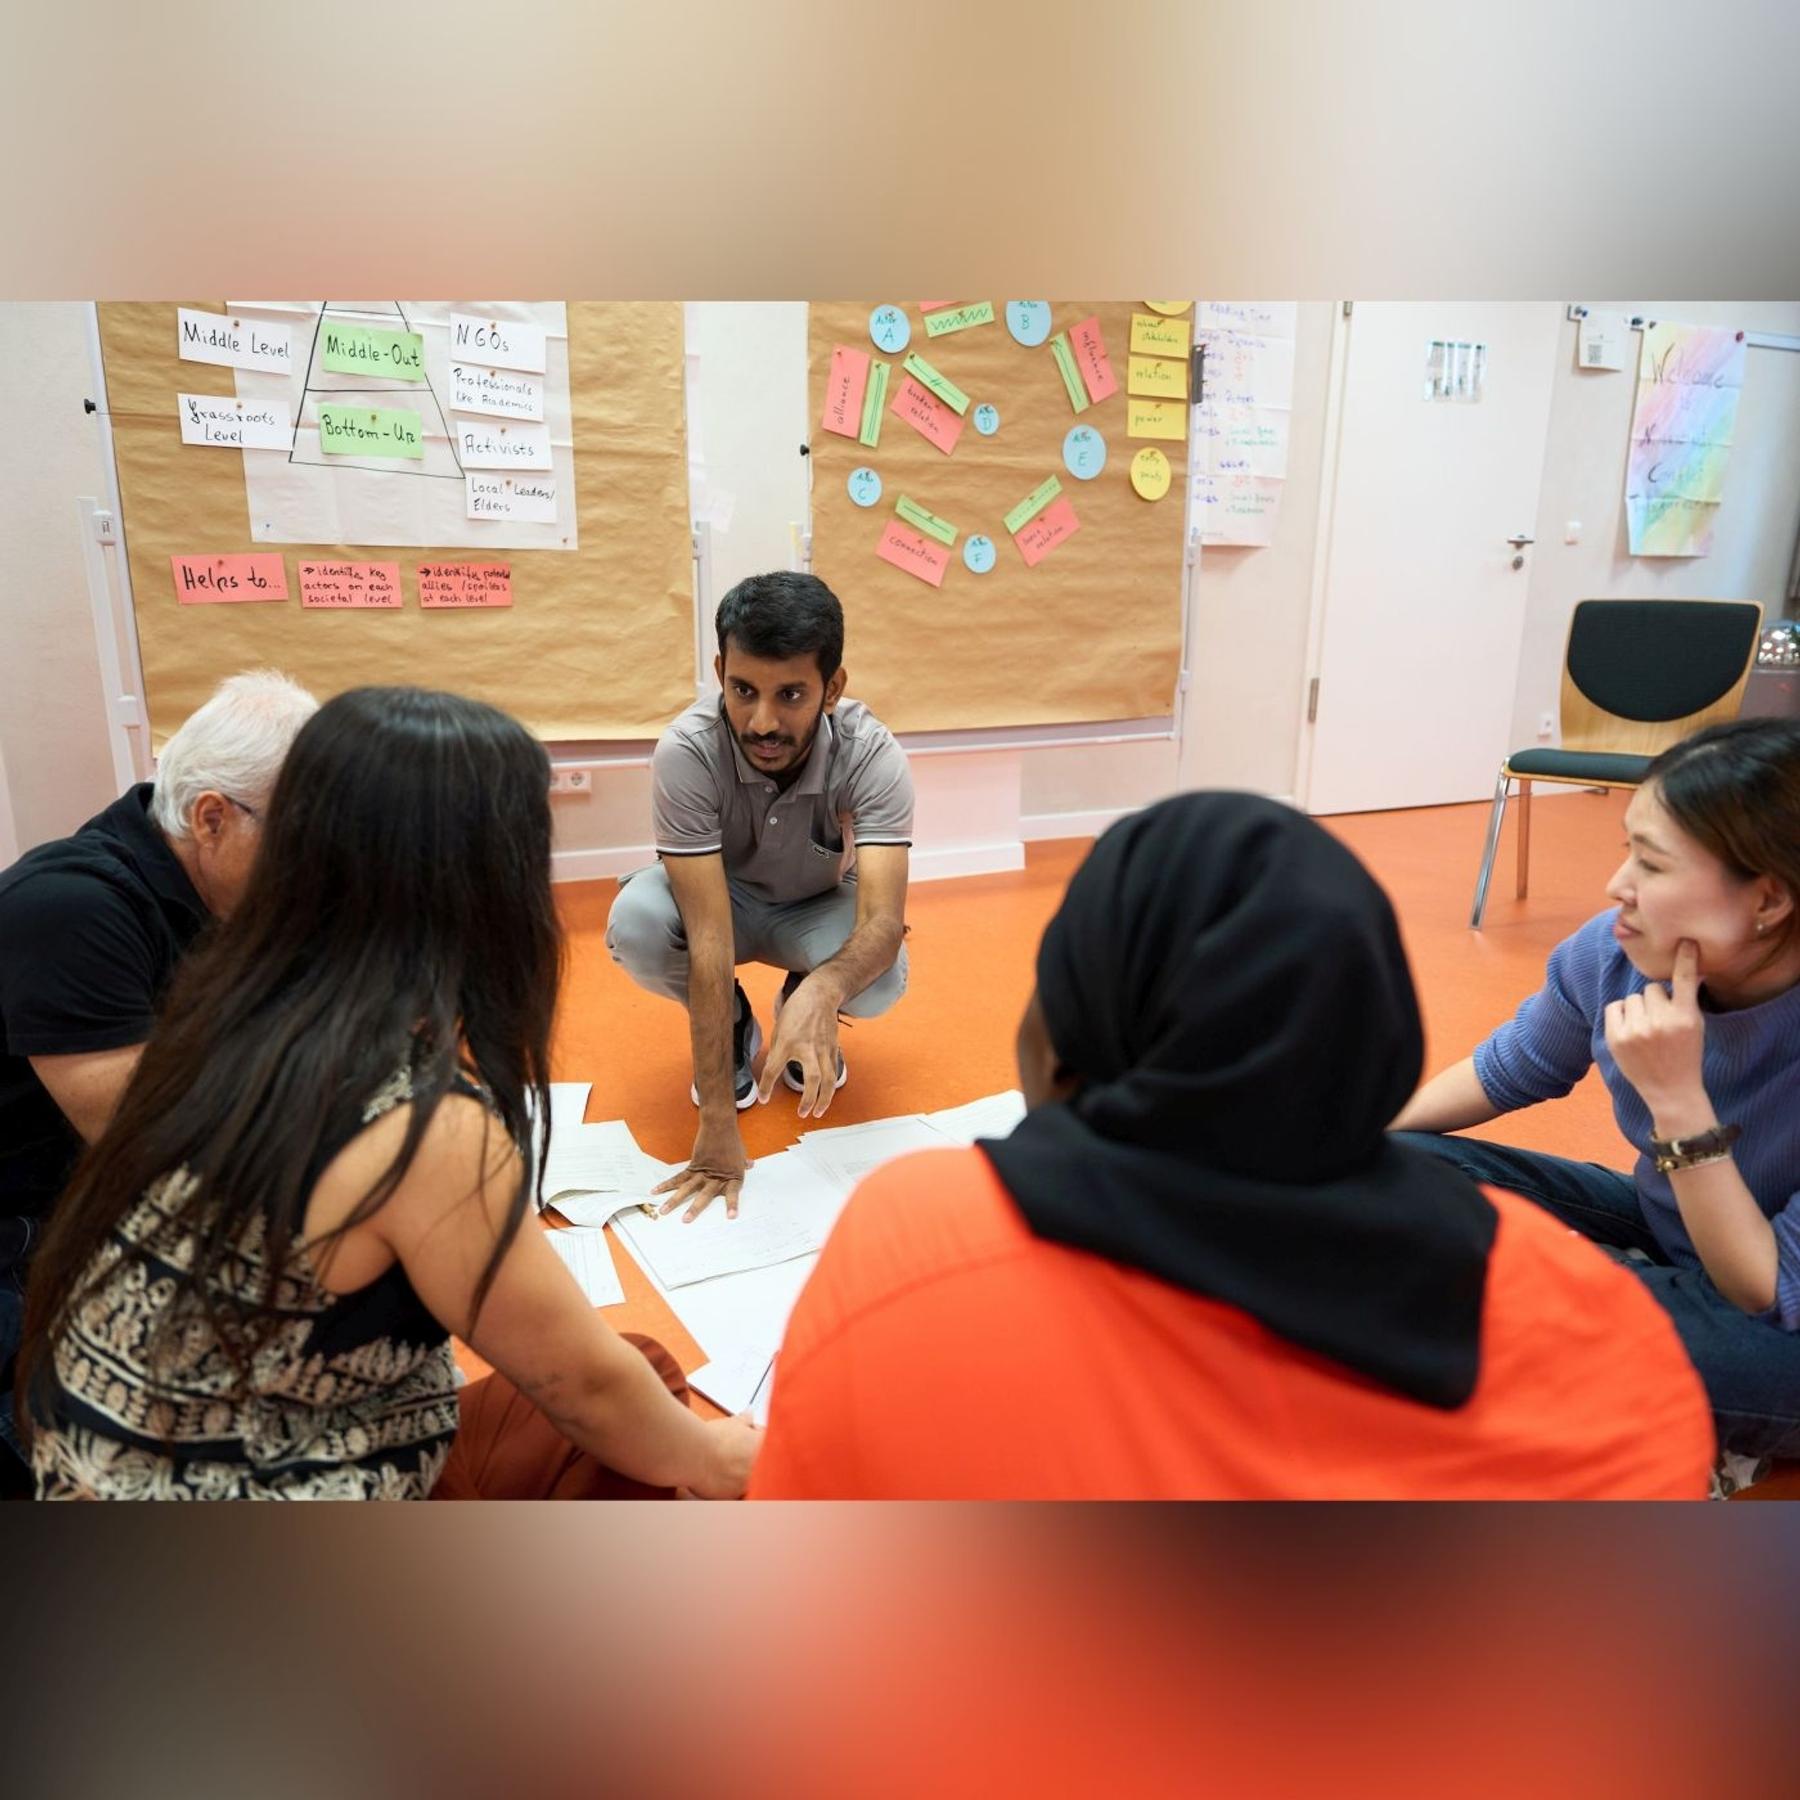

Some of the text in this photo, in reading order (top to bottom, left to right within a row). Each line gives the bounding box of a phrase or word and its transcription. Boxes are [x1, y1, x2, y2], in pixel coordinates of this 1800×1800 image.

[1021, 313, 1030, 330] B
[183, 320, 290, 359] Middle Level
[456, 323, 509, 352] NGOs
[881, 327, 895, 343] A
[326, 334, 421, 367] Middle-Out
[1083, 331, 1104, 382] influence
[453, 367, 532, 396] Professionals
[1136, 369, 1171, 381] relation
[833, 376, 850, 425] alliance
[187, 398, 275, 426] Grassroots
[911, 406, 940, 434] relation
[322, 413, 416, 444] Bottom-Up
[983, 417, 992, 431] D
[1135, 415, 1163, 428] power
[205, 422, 243, 444] Level
[464, 433, 534, 457] Activists
[1079, 451, 1089, 467] E
[471, 477, 503, 495] Local
[858, 487, 868, 500] C
[473, 497, 511, 513] Elders
[889, 535, 938, 566] connection
[974, 552, 983, 564] F
[182, 564, 239, 593] Helps
[369, 566, 387, 581] key
[433, 565, 481, 581] identify
[303, 582, 393, 592] actors on each
[421, 581, 453, 592] allies
[308, 592, 393, 604] societal level
[439, 594, 462, 604] each
[466, 592, 488, 603] level
